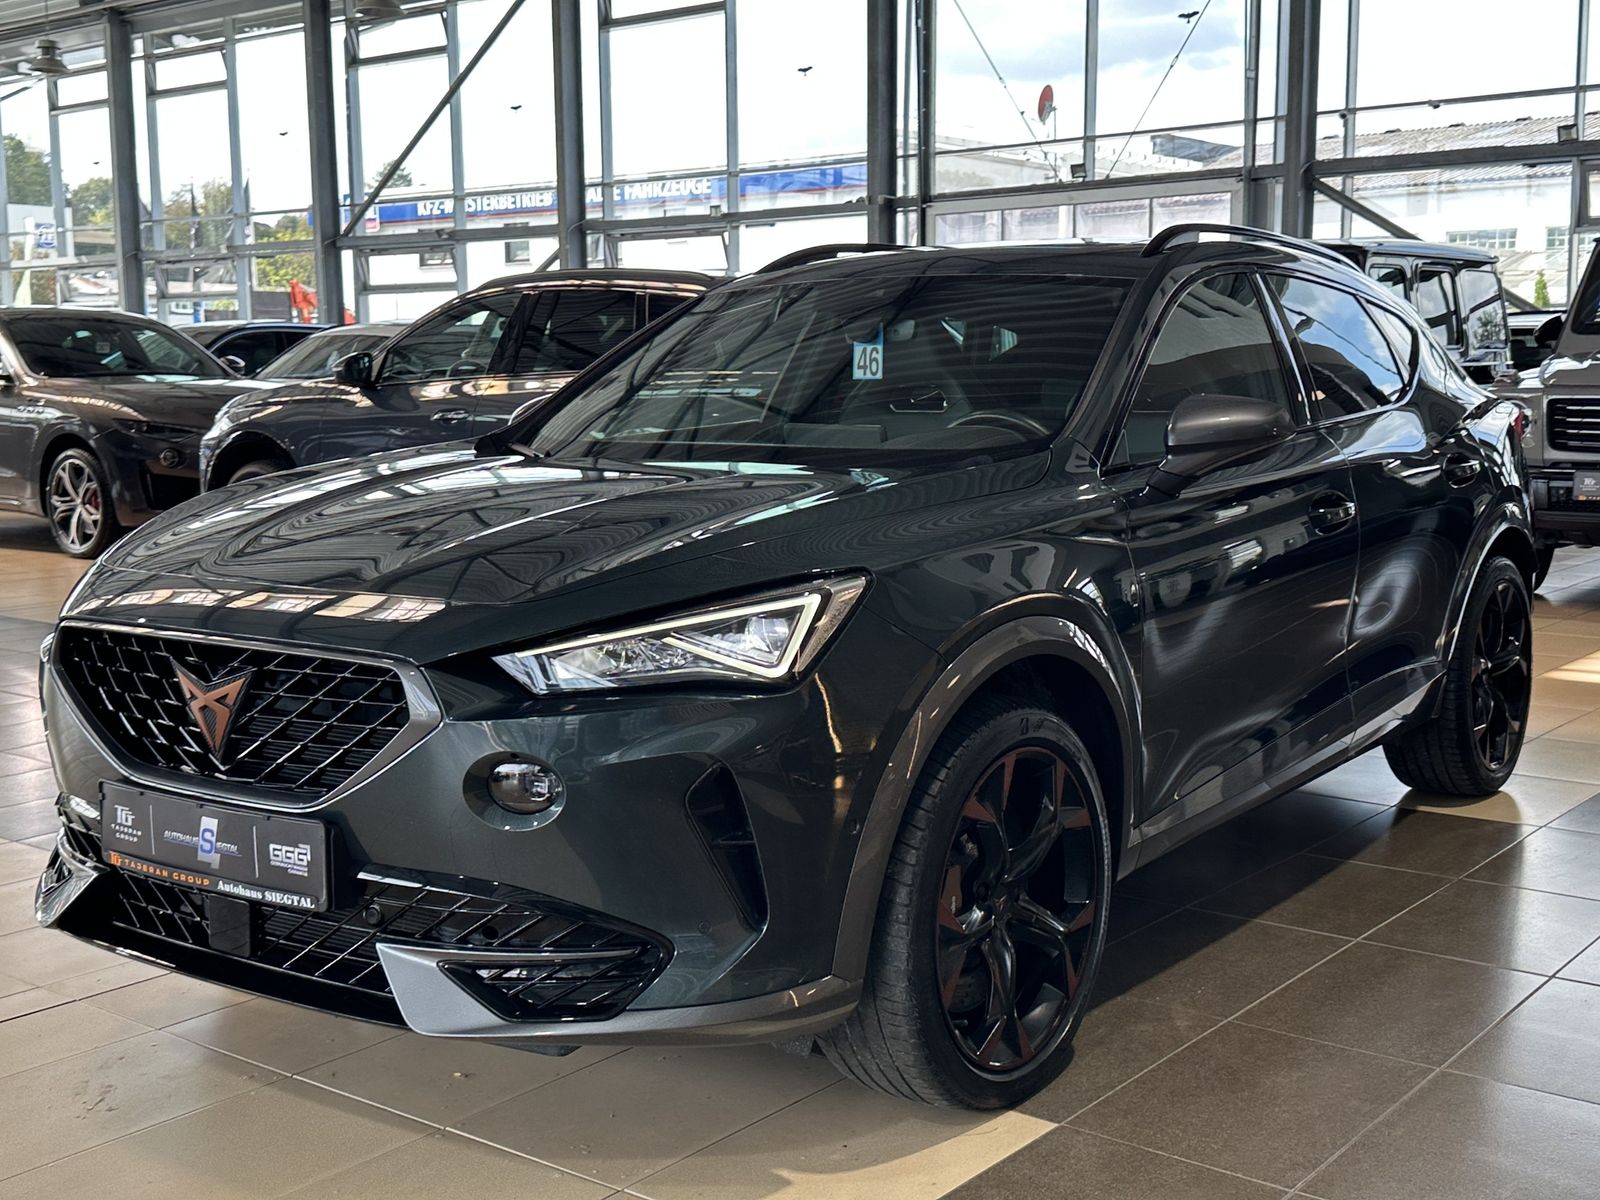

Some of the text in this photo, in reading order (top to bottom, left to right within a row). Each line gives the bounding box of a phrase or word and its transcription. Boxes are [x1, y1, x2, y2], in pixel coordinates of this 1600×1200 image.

[416, 178, 712, 216] KFZ-MISTERBETRIEB ALE FAHRZEUGE
[857, 346, 879, 376] 46
[269, 843, 309, 866] GGG
[173, 871, 210, 886] GROUP
[217, 880, 315, 909] Autohaus SIEGTAL
